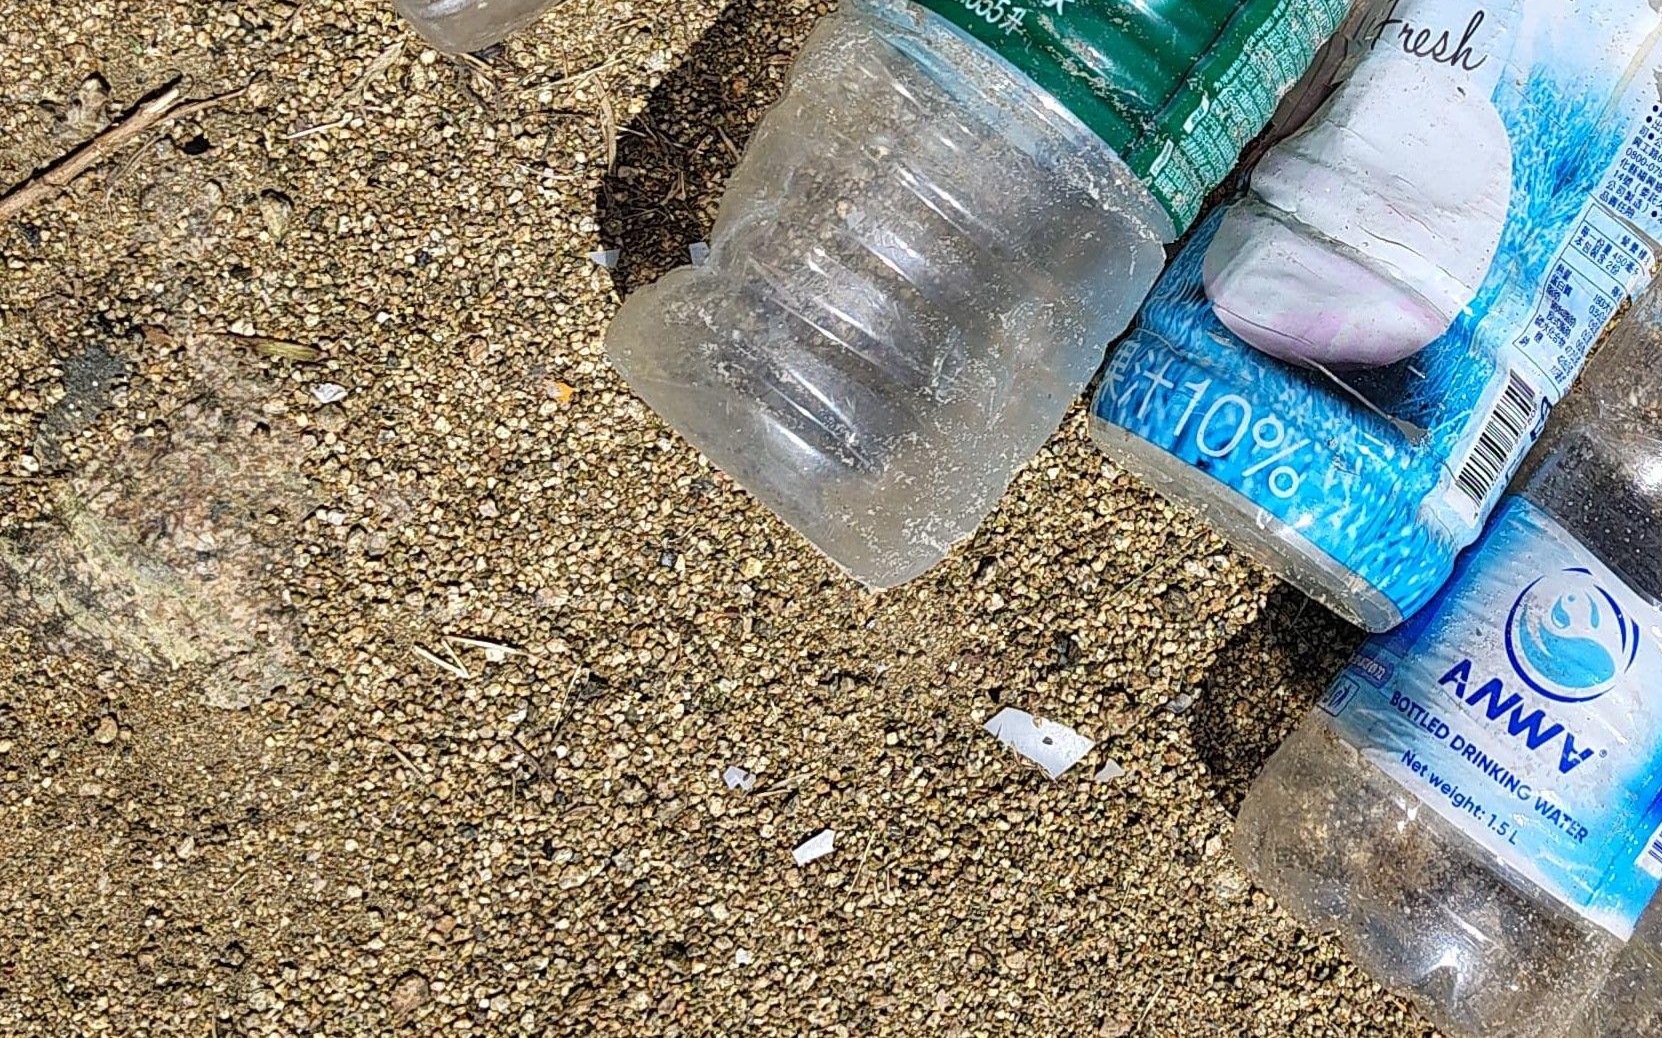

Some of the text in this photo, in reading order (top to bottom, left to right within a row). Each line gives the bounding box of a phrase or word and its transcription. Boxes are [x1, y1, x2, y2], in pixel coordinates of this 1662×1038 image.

[1389, 690, 1589, 844] BOTTLED DRINKING WATER
[1438, 659, 1597, 776] ANWA
[1400, 749, 1427, 779] Net
[1428, 774, 1487, 823] weight:
[1486, 812, 1508, 837] 1.5
